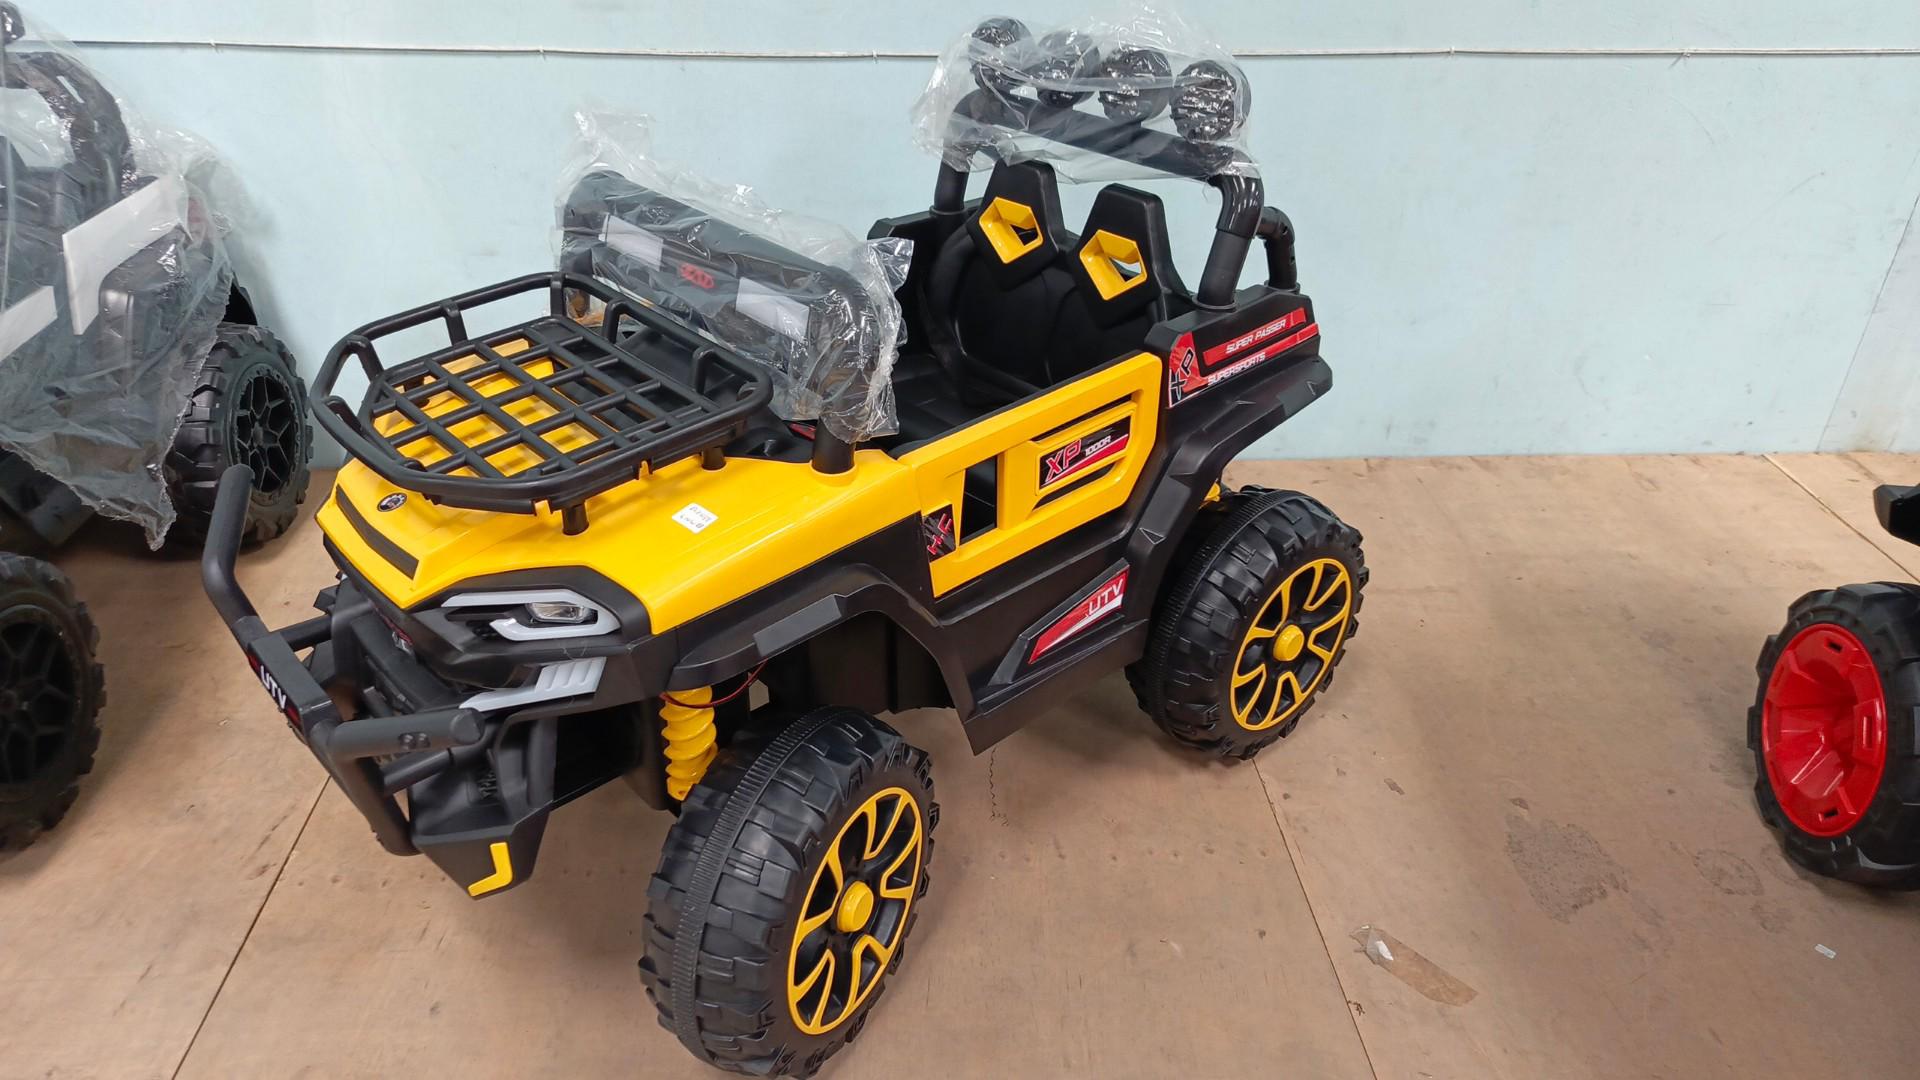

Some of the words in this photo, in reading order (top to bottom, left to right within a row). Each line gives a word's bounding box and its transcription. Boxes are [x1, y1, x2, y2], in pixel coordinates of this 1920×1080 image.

[1225, 336, 1254, 354] SUPER
[1254, 319, 1287, 342] PASSER
[1170, 347, 1196, 400] XP
[1207, 352, 1266, 386] SUPERSPORTS
[1045, 438, 1082, 483] XP
[1084, 435, 1112, 457] 1000R
[1087, 578, 1124, 615] UTV
[260, 664, 288, 710] UTV
